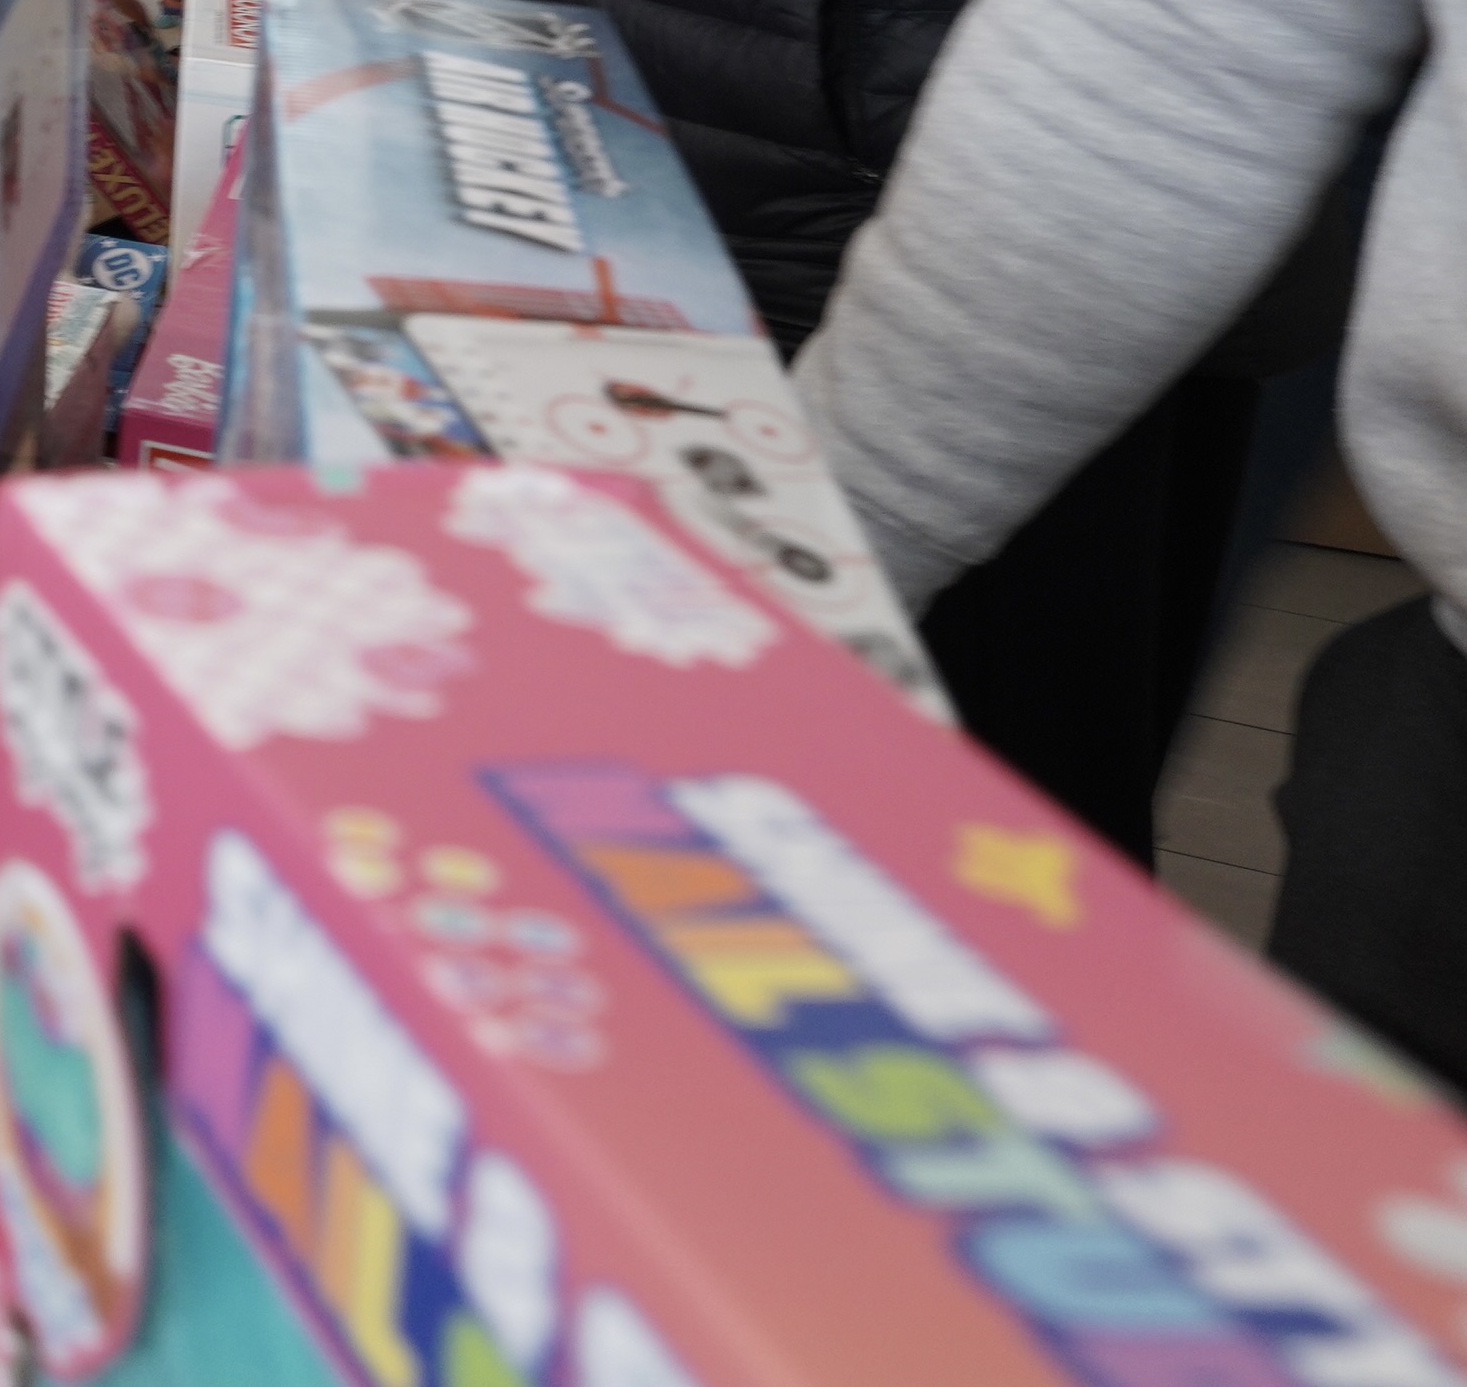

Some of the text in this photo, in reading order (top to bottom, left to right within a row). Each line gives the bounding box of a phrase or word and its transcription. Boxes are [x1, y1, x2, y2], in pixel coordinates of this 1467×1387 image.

[423, 50, 539, 114] AIR
[437, 102, 586, 253] HOCKEY
[103, 250, 140, 283] DC
